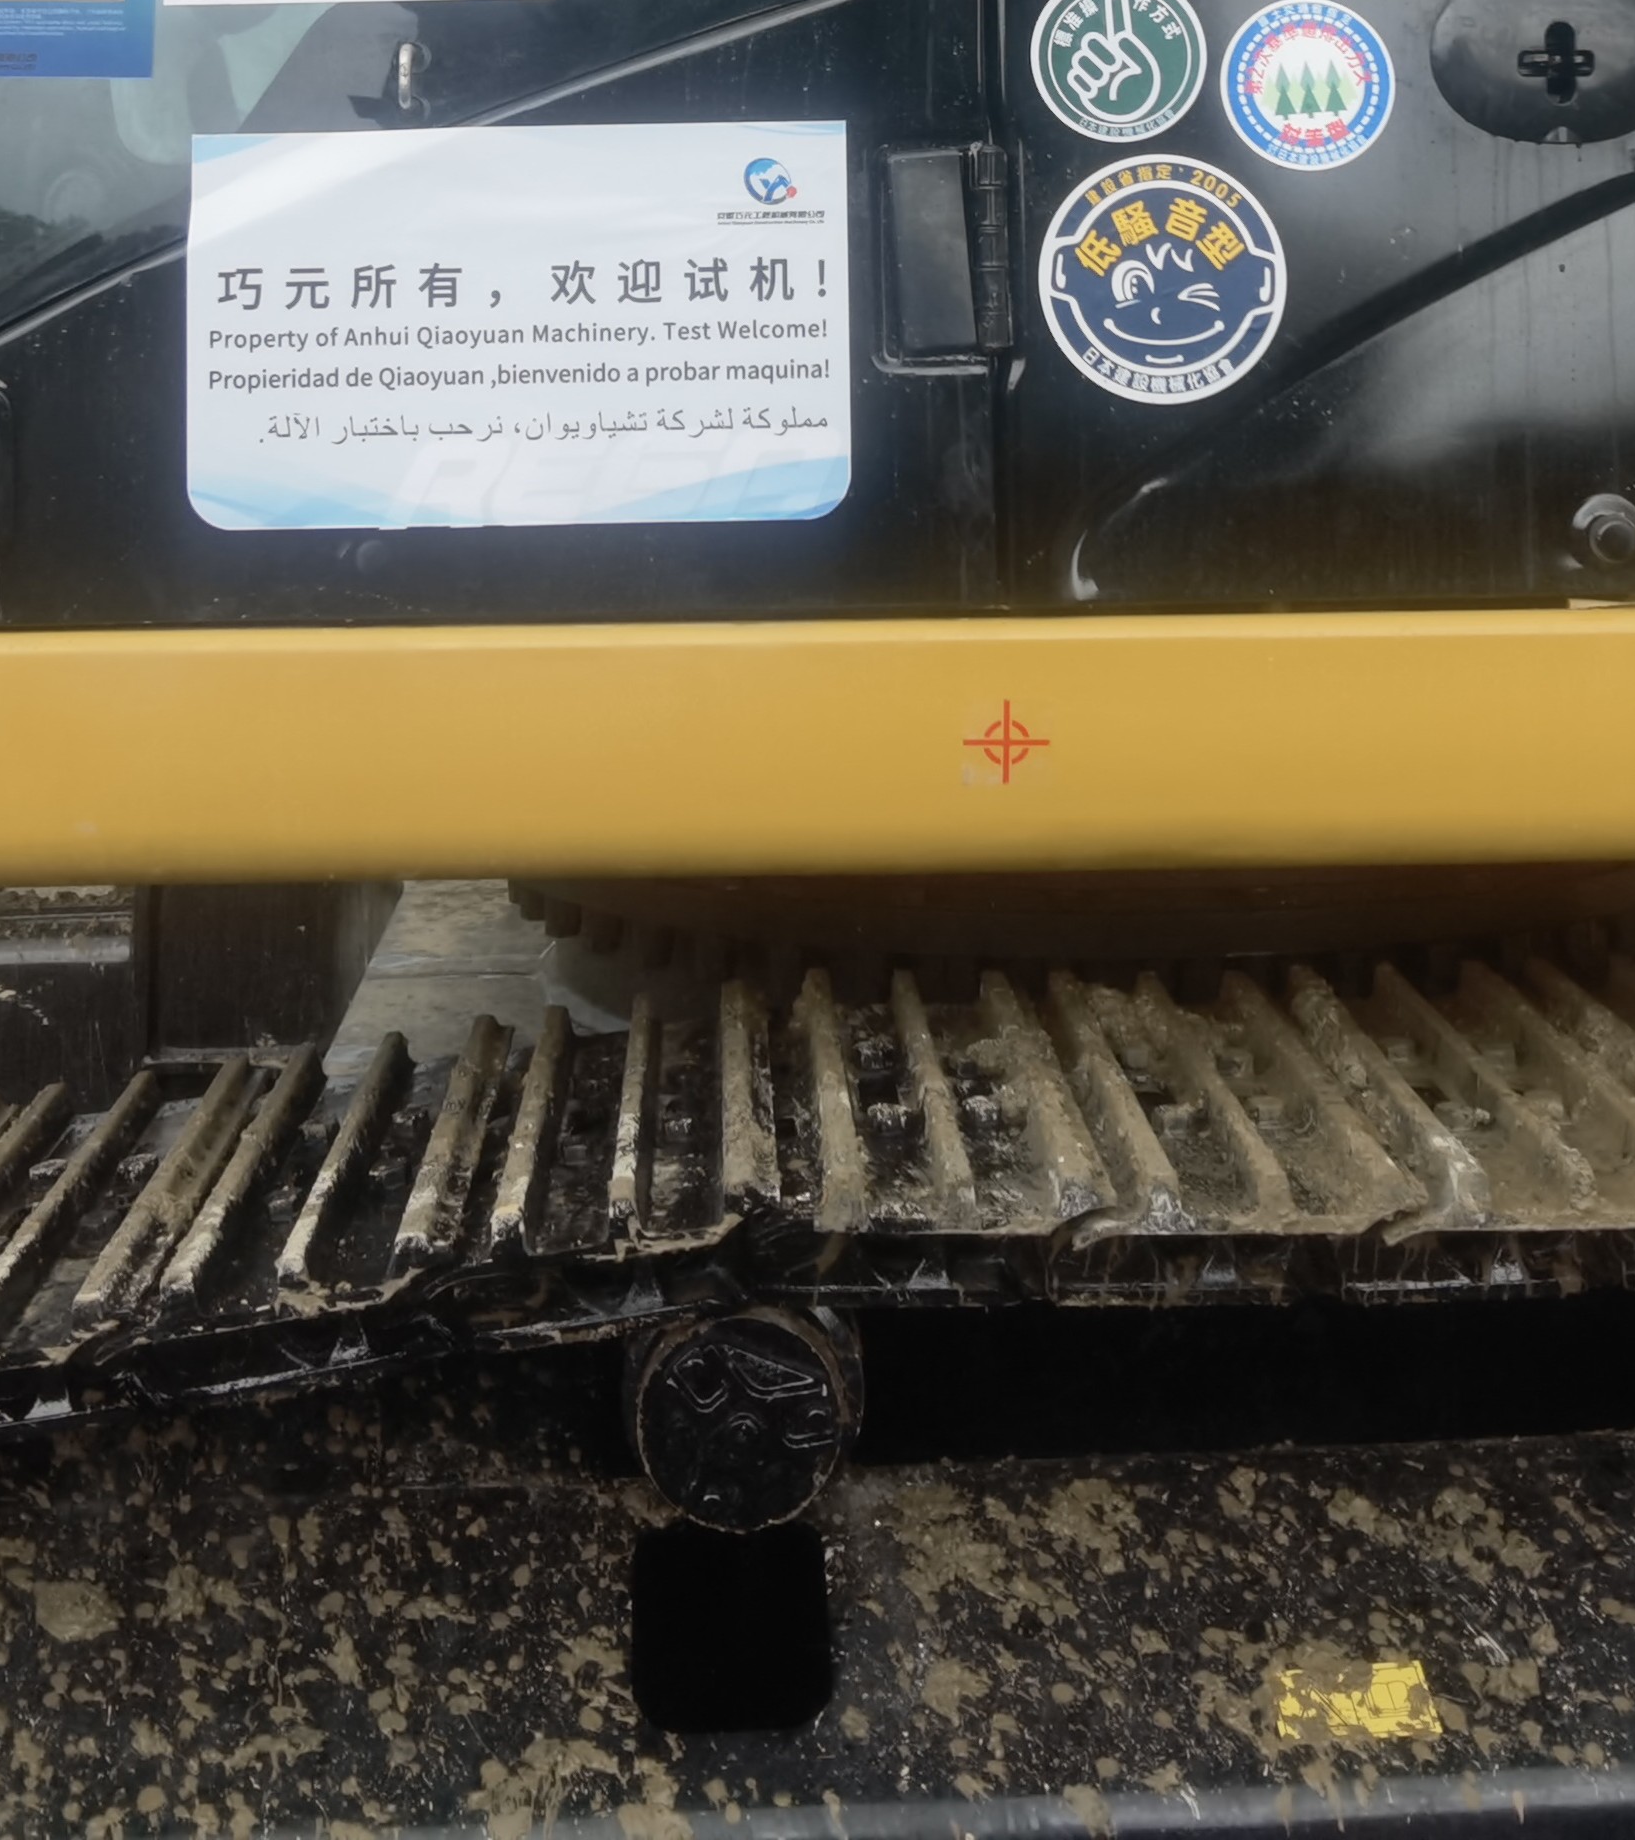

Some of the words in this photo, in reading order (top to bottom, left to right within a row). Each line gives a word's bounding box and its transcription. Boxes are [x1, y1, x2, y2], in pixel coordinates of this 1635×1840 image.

[1189, 170, 1243, 209] 2005
[209, 329, 309, 352] Property
[315, 326, 339, 347] of
[344, 325, 409, 347] Anhui
[416, 325, 524, 349] Qiaoyuan
[532, 322, 656, 346] Machinery.
[663, 321, 711, 341] Test
[717, 318, 828, 340] Welcome!
[209, 367, 339, 394] Propieridad
[345, 366, 373, 388] de
[378, 365, 484, 391] Qiaoyuan
[627, 367, 639, 382] a
[646, 361, 720, 387] probar
[726, 358, 830, 384] maquina!
[330, 414, 420, 445] باختبار
[428, 415, 503, 442] نرحب
[656, 407, 734, 439] لشركة
[741, 405, 828, 436] مملوكة
